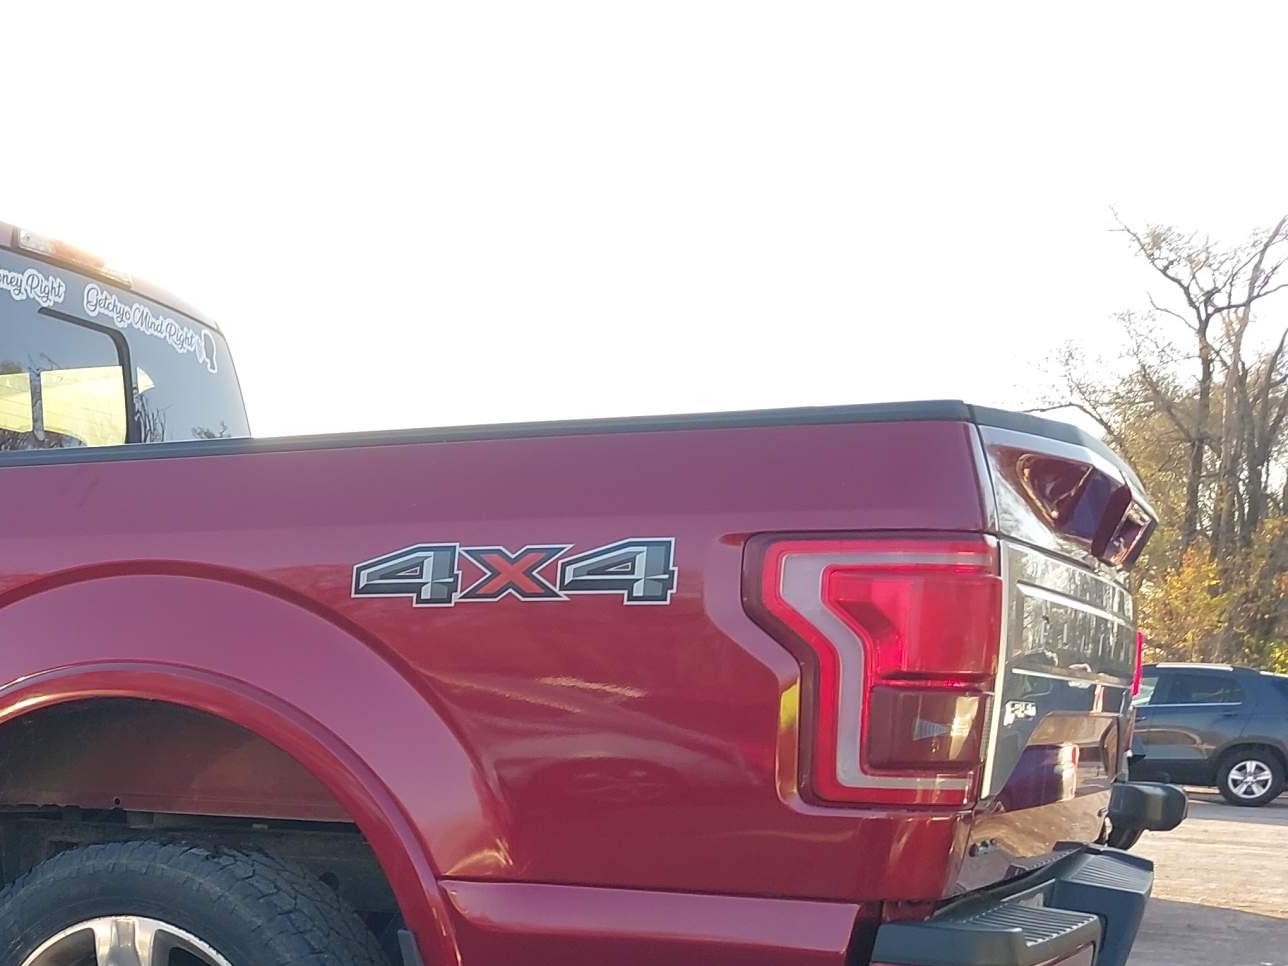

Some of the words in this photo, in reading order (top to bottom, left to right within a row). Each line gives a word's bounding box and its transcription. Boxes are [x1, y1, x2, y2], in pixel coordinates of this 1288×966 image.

[25, 272, 64, 304] Right
[85, 286, 131, 324] Getchyo
[132, 305, 163, 335] Mind
[165, 322, 194, 350] Right
